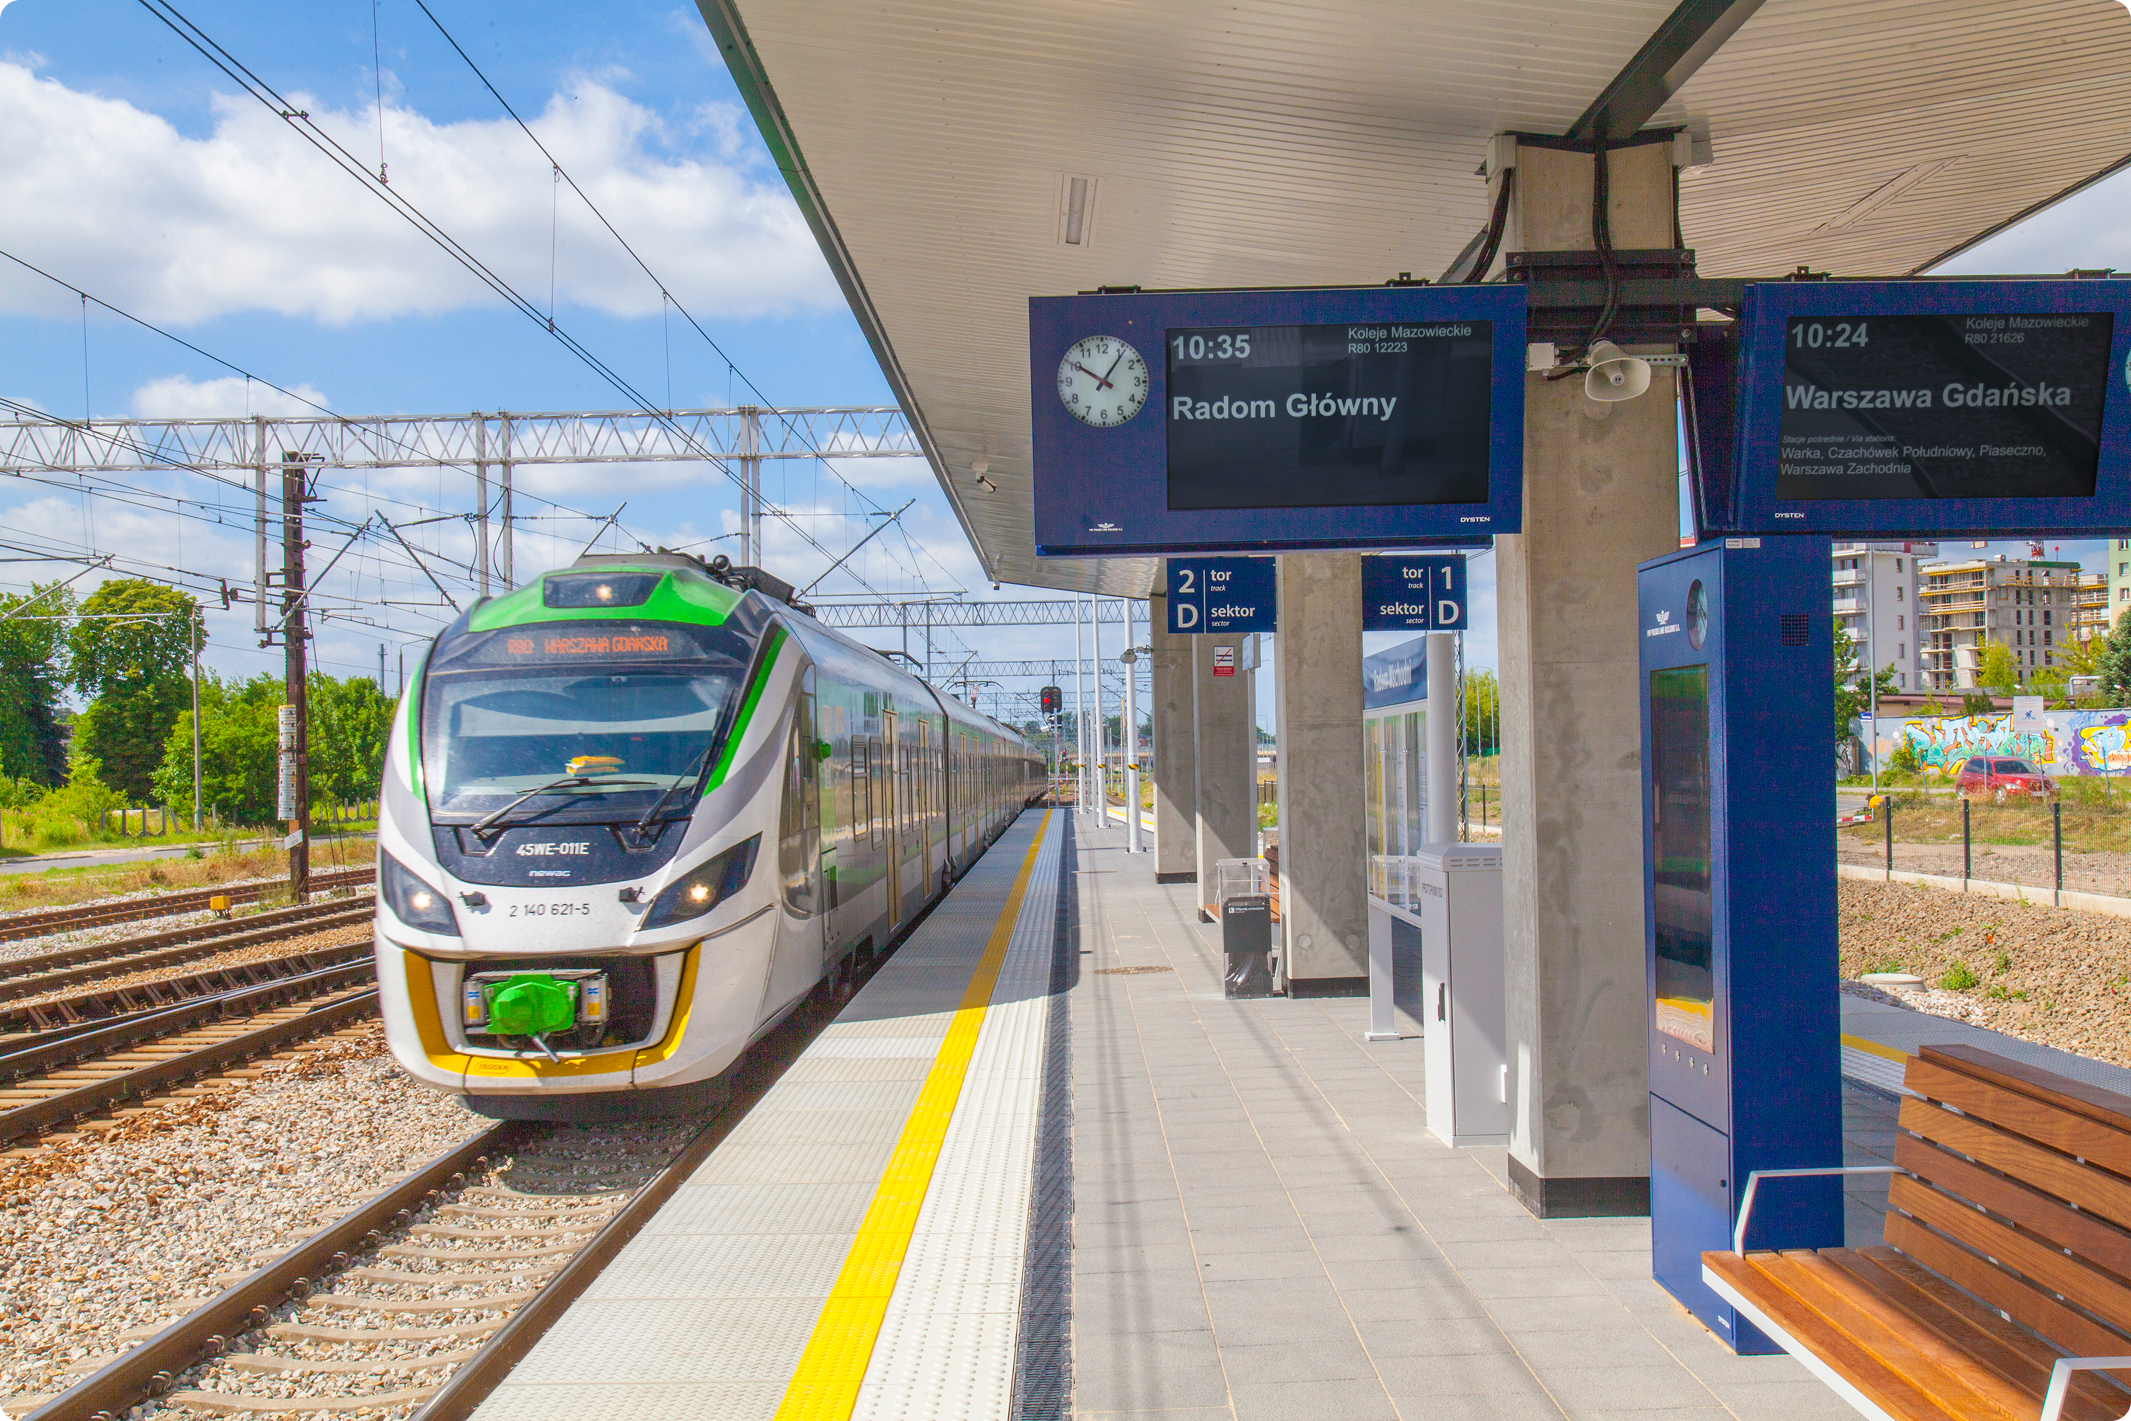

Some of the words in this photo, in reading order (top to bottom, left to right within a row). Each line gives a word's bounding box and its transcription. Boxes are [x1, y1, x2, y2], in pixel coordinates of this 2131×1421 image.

[1966, 317, 2006, 332] Koleje
[2008, 315, 2090, 329] Mazowieckie
[1348, 327, 1388, 341] Koleje
[1391, 324, 1472, 338] Mazowieckie
[1791, 322, 1869, 348] 10:24
[1965, 333, 1988, 344] R80
[1990, 332, 2025, 344] 21626
[1080, 348, 1091, 358] 11
[1096, 343, 1109, 354] 12
[1172, 334, 1251, 360] 10:35
[1348, 343, 1371, 354] R80
[1374, 342, 1408, 353] 12223
[1070, 361, 1082, 372] 10
[1128, 360, 1135, 370] 2
[1065, 377, 1073, 387] 9
[1133, 376, 1141, 387] 3
[1071, 393, 1079, 404] 8
[1128, 393, 1136, 404] 4
[1786, 385, 1932, 410] Warszawa
[1942, 382, 2072, 408] Gdańska
[1085, 405, 1092, 416] 7
[1117, 405, 1124, 416] 5
[1173, 395, 1276, 420] Radom
[1286, 392, 1398, 421] Główny
[1100, 409, 1108, 420] 6
[1782, 435, 1806, 445] Stacje
[1807, 434, 1845, 444] pośrednie
[1851, 435, 1863, 443] Via
[1864, 434, 1896, 443] stations:
[1781, 447, 1824, 460] Warka,
[1828, 446, 1900, 459] Czachówek
[1903, 445, 1976, 460] Południowy,
[1979, 444, 2047, 458] Piaseczno,
[1780, 463, 1844, 475] Warszawa
[1847, 462, 1912, 475] Zachodnia
[1179, 569, 1195, 593] 2
[1210, 570, 1232, 581] tor
[1402, 567, 1424, 579] tor
[1441, 566, 1452, 590] 1
[1177, 604, 1199, 628] D
[1211, 604, 1256, 617] sektor
[1380, 601, 1424, 615] sektor
[1438, 600, 1459, 625] D
[544, 637, 611, 654] WARSZAWA
[516, 842, 590, 856] 45WE-011E
[509, 904, 518, 917] 2
[523, 903, 546, 916] 140
[550, 902, 590, 916] 621-5
